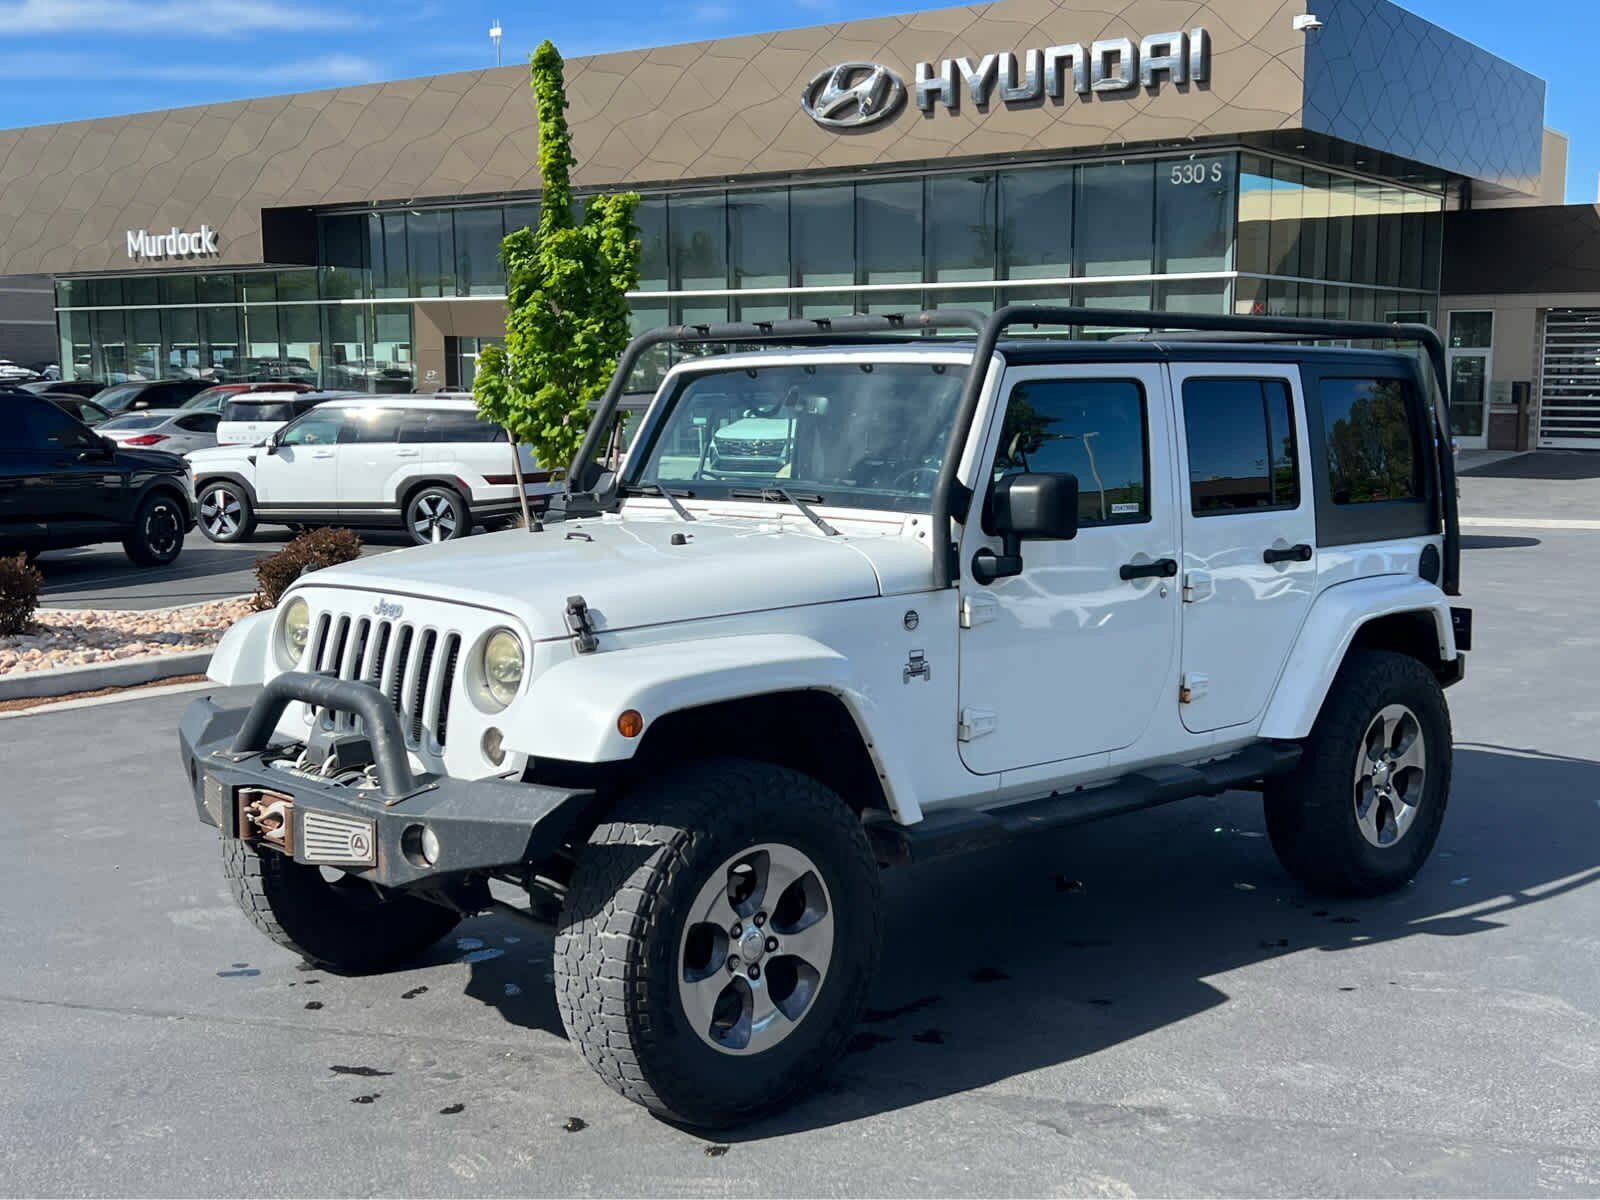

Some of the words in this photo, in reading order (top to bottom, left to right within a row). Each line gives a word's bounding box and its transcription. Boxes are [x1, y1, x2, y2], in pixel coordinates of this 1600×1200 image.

[915, 27, 1209, 111] HYUNDAI
[1170, 164, 1205, 184] 530
[1211, 162, 1222, 182] S
[127, 224, 218, 258] Murdock
[373, 597, 404, 621] Jeep
